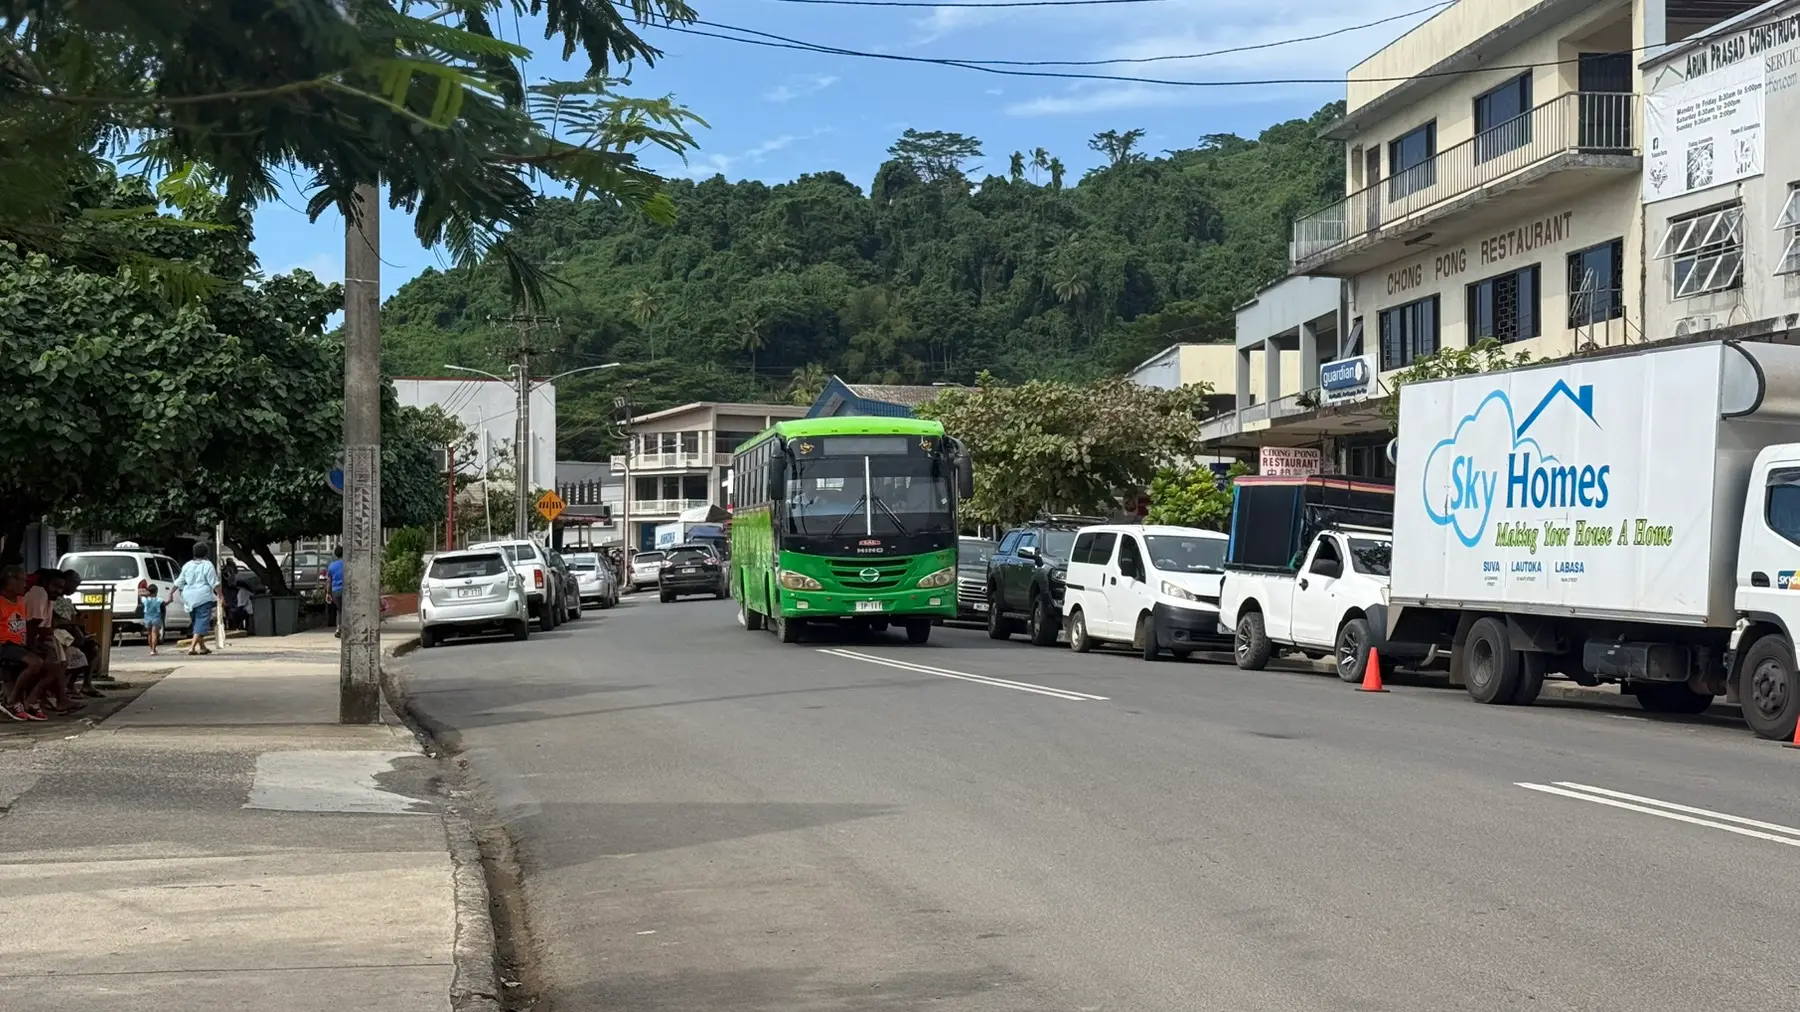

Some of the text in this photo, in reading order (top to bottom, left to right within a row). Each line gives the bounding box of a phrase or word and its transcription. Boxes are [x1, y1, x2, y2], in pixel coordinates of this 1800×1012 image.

[1685, 50, 1707, 81] ARUN
[1710, 36, 1745, 72] PRASAD
[1765, 46, 1800, 73] SERVIC
[1676, 106, 1694, 116] Monday
[1702, 97, 1717, 107] Friday
[1744, 83, 1762, 93] 5:00pm
[1676, 113, 1696, 124] Saturday
[1676, 122, 1692, 132] Sunday
[1387, 211, 1573, 295] CHONG PONG RESTAURANT
[1323, 364, 1355, 387] guardian
[1262, 448, 1318, 458] CHONG PONG
[1262, 457, 1318, 468] RESTAURANT
[1451, 452, 1610, 512] Sky Homes
[1495, 518, 1674, 554] Making Your House A Home
[1483, 560, 1585, 573] SUVA LAUTOKA LABASA
